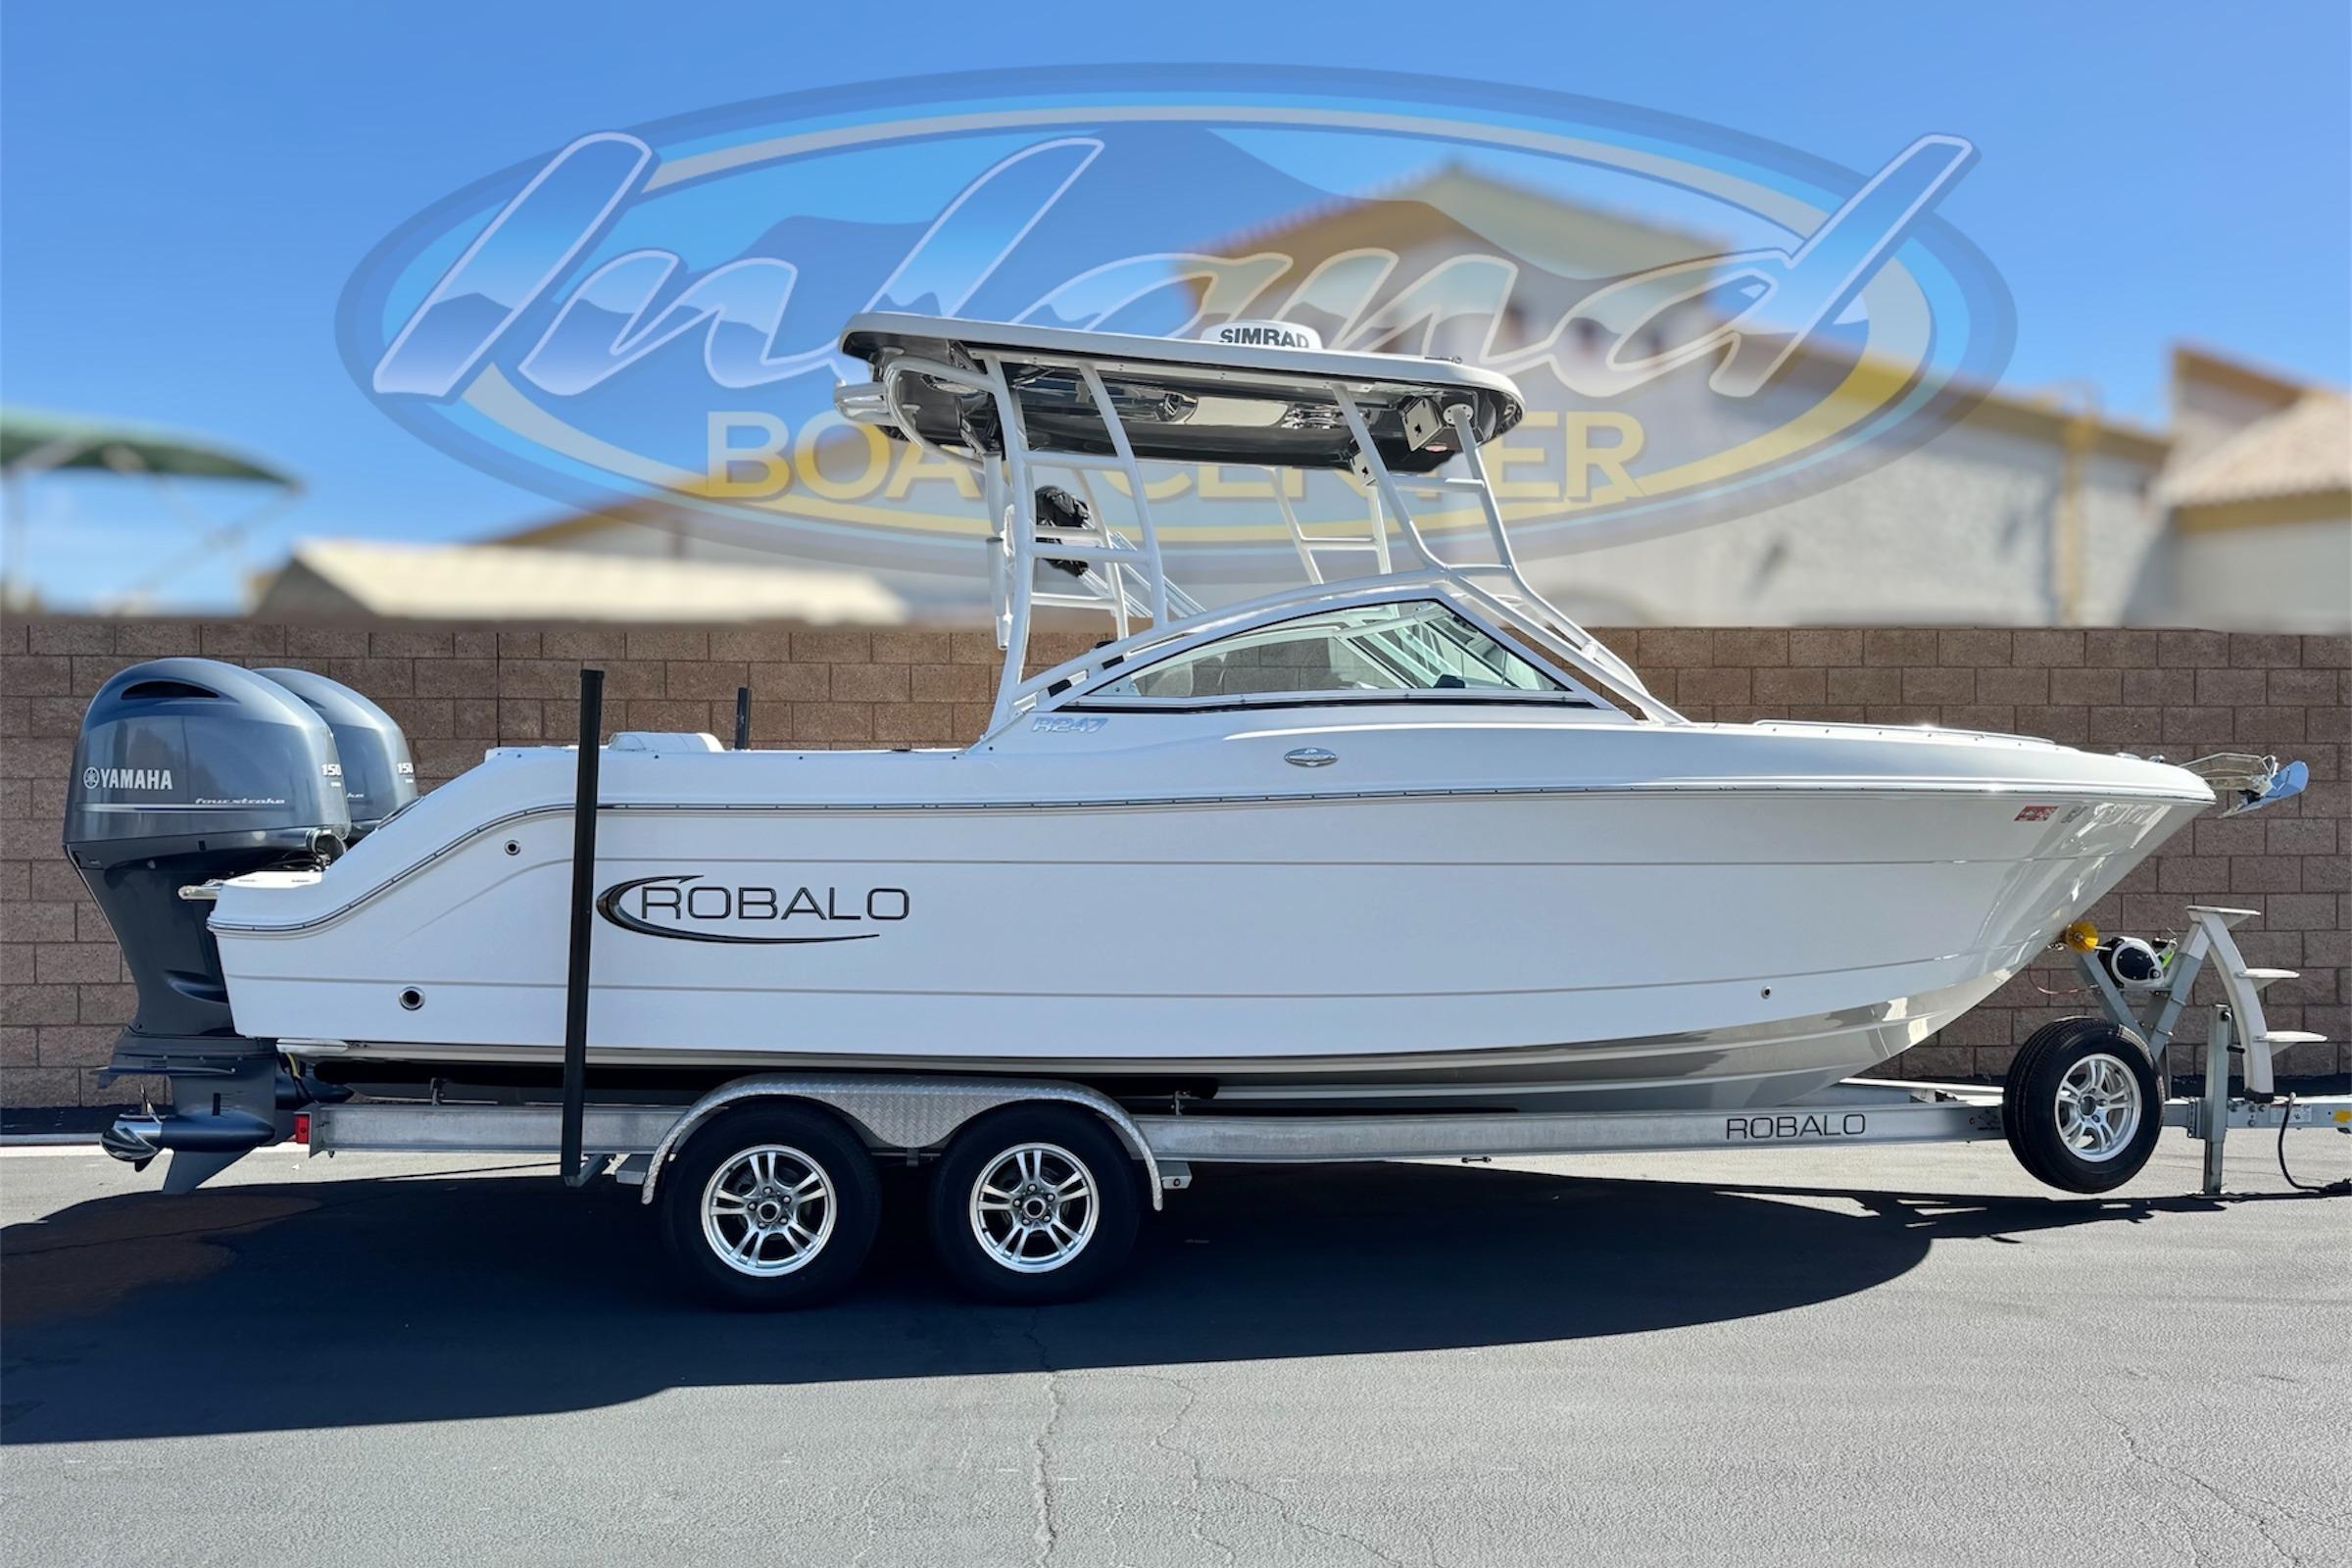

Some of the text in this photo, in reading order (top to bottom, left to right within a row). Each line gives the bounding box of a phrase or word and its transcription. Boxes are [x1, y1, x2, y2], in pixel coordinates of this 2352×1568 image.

[1219, 326, 1310, 349] SIMRAD
[1031, 716, 1109, 733] R247
[100, 767, 173, 790] YAMAHA
[321, 763, 342, 777] 150
[641, 886, 910, 921] ROBALO
[1726, 1113, 1867, 1141] ROBALO
